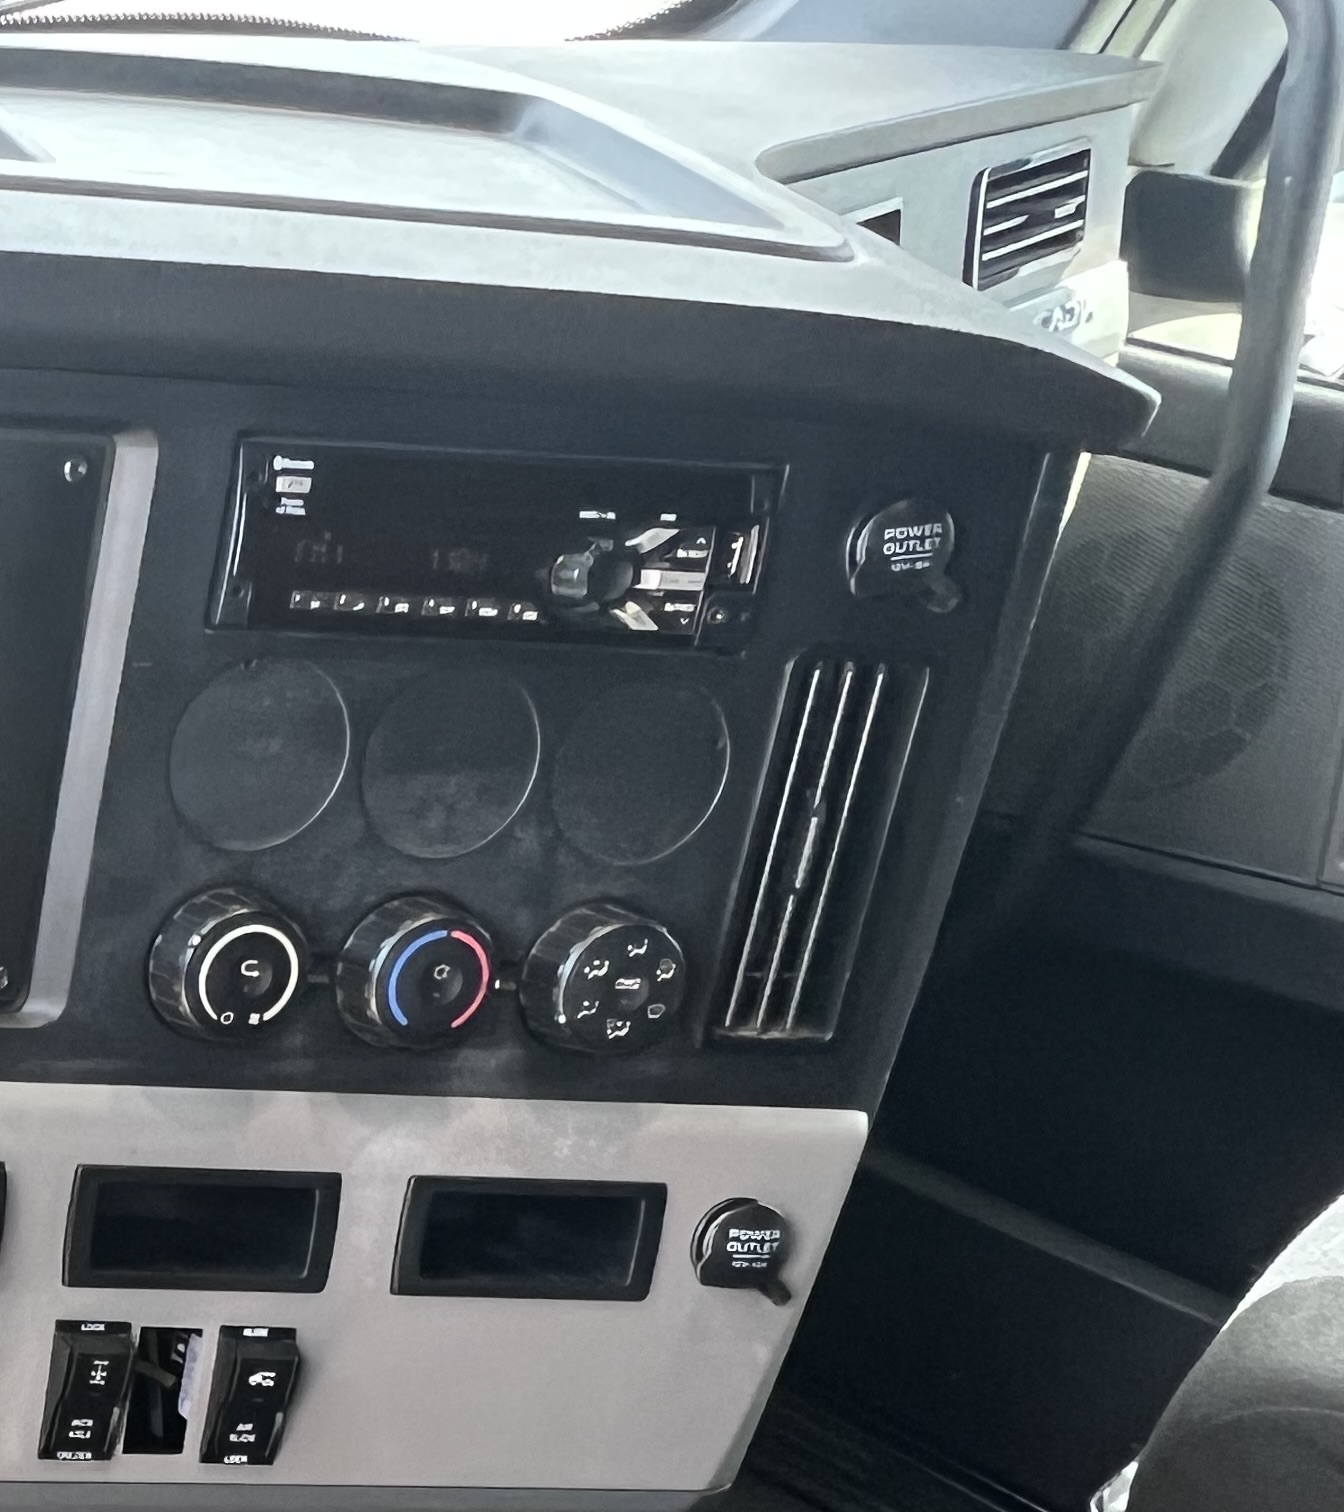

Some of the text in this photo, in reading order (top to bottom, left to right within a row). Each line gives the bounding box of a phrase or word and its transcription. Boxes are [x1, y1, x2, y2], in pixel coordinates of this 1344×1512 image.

[884, 523, 942, 540] POWER
[882, 537, 941, 555] OUTLET
[728, 1228, 781, 1241] POWER
[726, 1241, 780, 1254] OUTLET
